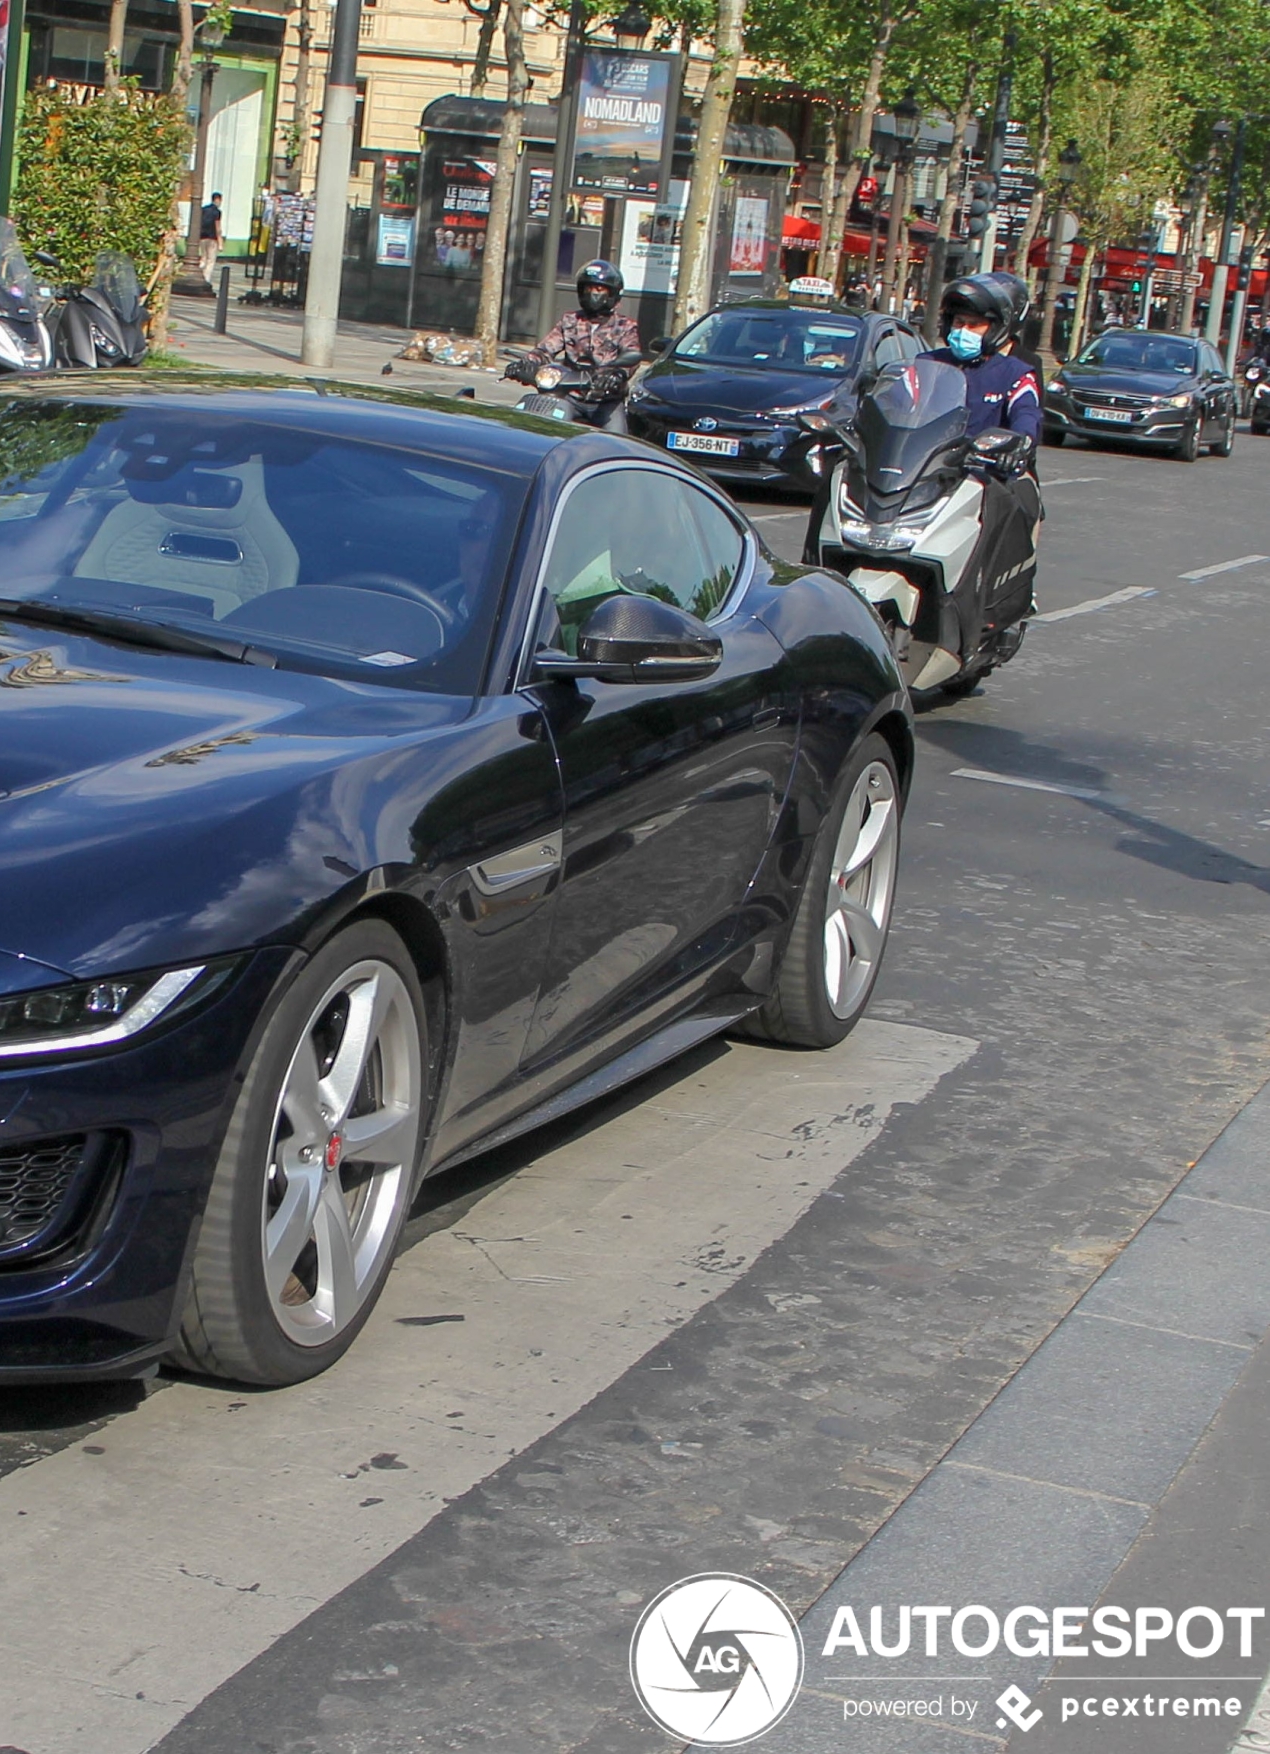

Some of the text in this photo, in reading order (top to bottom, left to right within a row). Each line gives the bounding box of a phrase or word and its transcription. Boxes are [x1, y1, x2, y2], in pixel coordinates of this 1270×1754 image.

[583, 96, 662, 124] NOMADLAND
[446, 187, 458, 198] LE
[443, 198, 456, 210] DE
[801, 278, 821, 287] TAXI
[674, 435, 731, 453] EJ-356-NT
